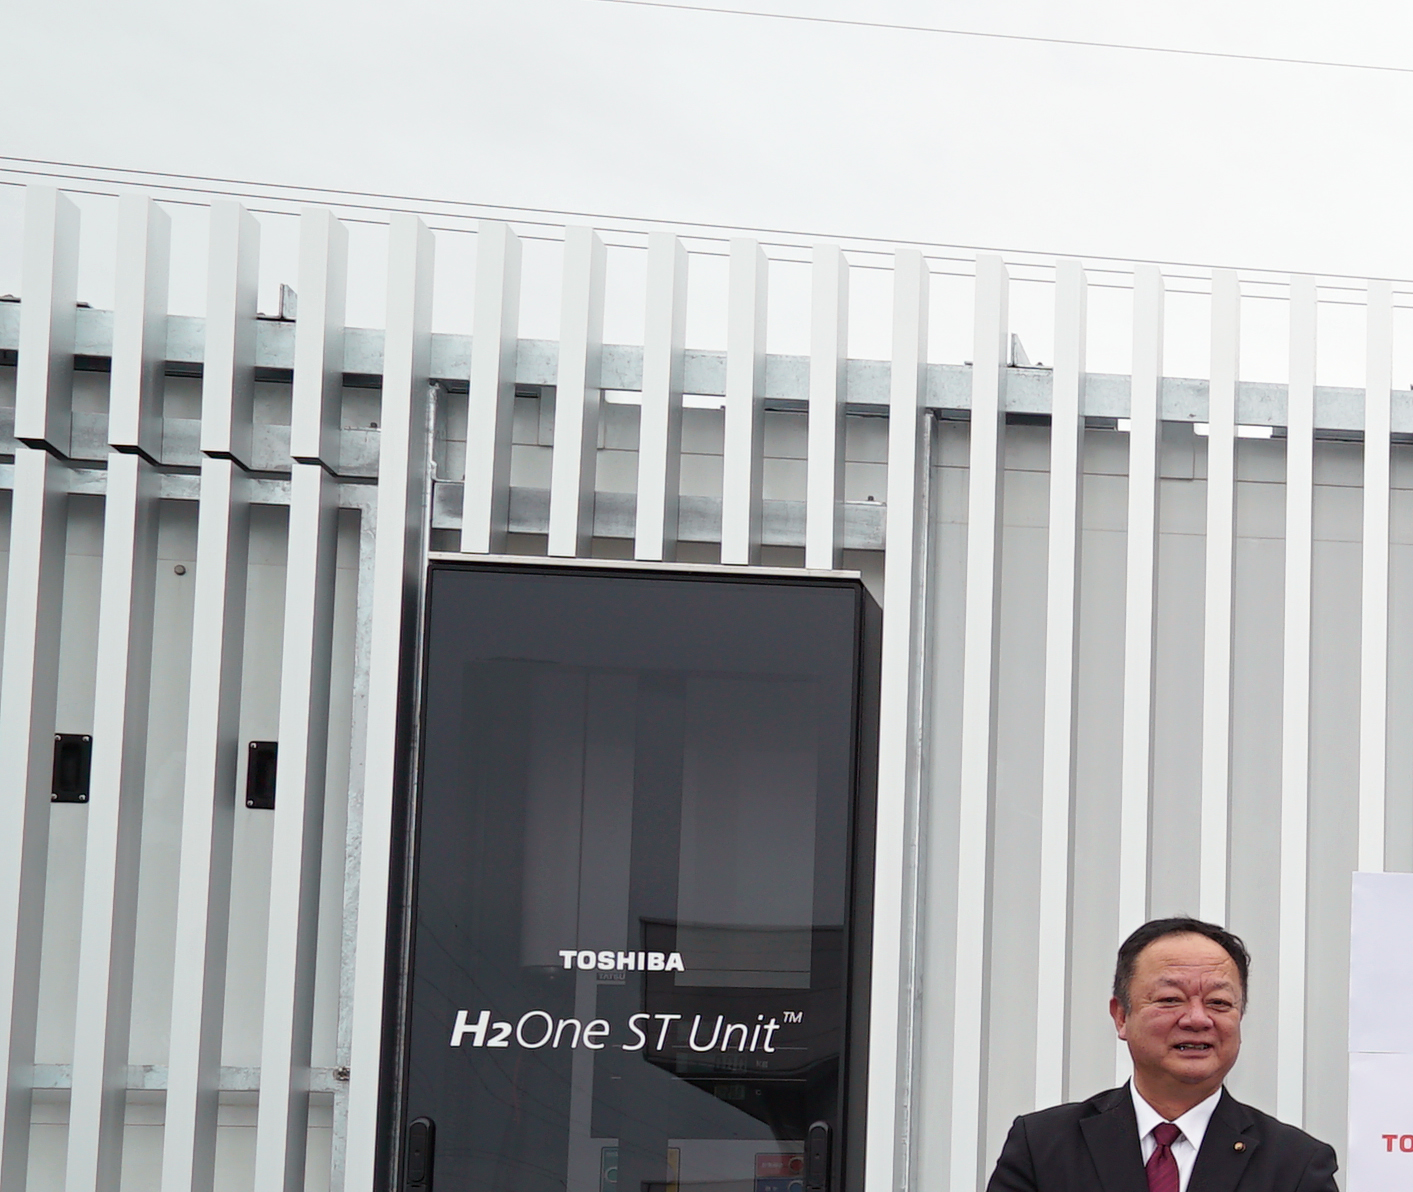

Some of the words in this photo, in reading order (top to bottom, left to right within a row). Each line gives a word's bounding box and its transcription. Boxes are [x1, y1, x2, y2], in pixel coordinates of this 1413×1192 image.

[559, 950, 685, 972] TOSHIBA
[450, 1009, 611, 1050] H2One
[621, 1013, 682, 1051] ST
